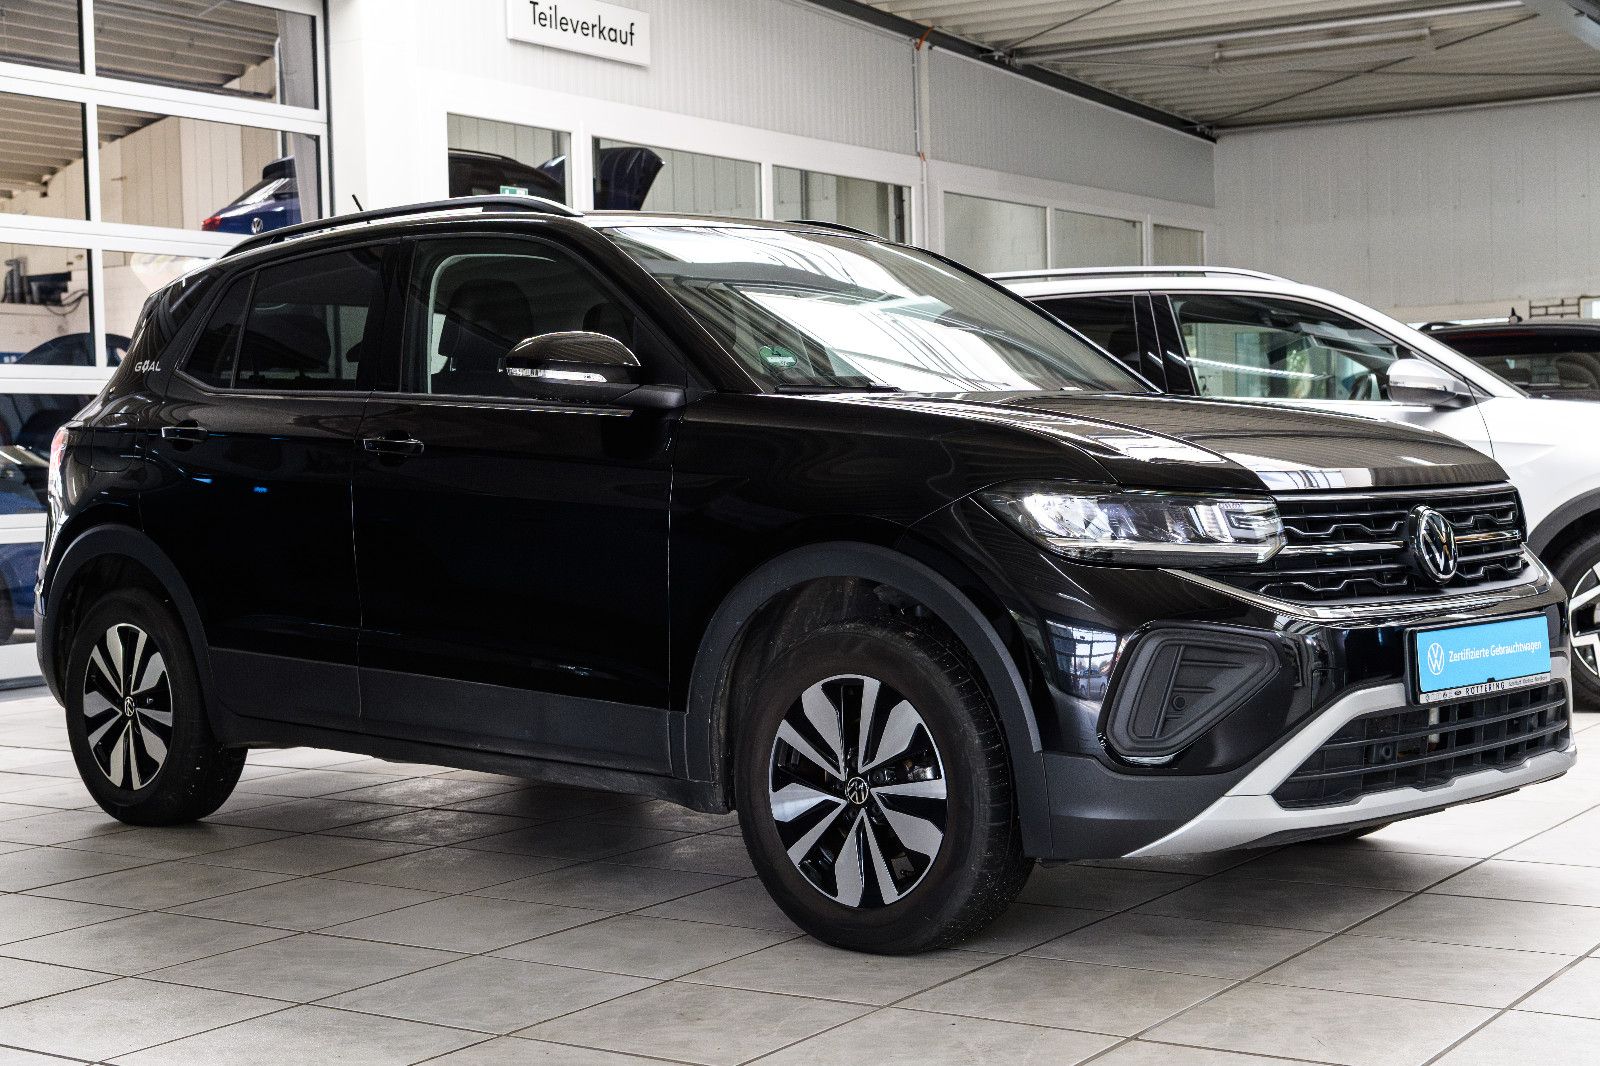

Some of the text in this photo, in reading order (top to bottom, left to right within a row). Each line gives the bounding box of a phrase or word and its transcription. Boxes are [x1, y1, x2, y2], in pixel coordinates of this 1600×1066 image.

[529, 0, 635, 46] Teileverkauf
[1428, 642, 1445, 675] VW
[1448, 640, 1542, 663] Zertifizierte Gebrauchtwagen
